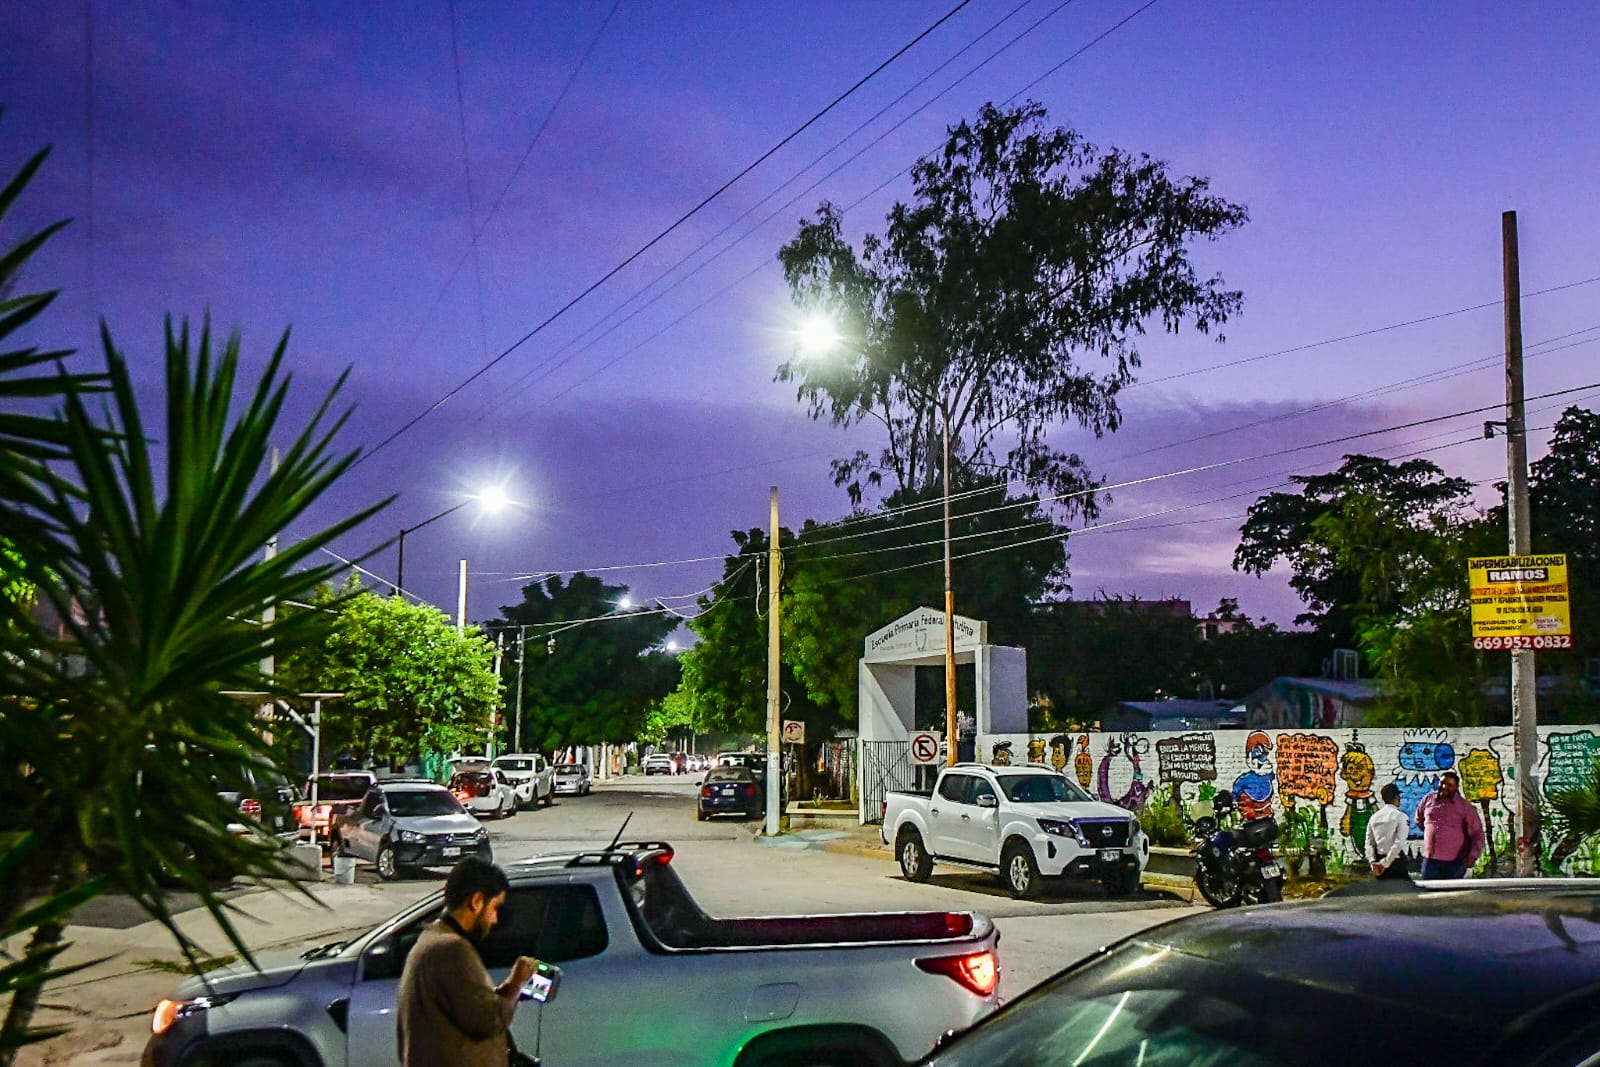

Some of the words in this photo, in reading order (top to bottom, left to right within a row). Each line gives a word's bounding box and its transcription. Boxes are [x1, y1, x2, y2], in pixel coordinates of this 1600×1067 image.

[1470, 556, 1564, 569] IMPERMEABILIZACIONES
[1489, 569, 1545, 581] RAMOS
[871, 629, 894, 650] Escuela
[895, 617, 919, 636] Primaria
[1473, 637, 1502, 649] 669
[1503, 637, 1531, 649] 952
[1533, 636, 1571, 648] 0832
